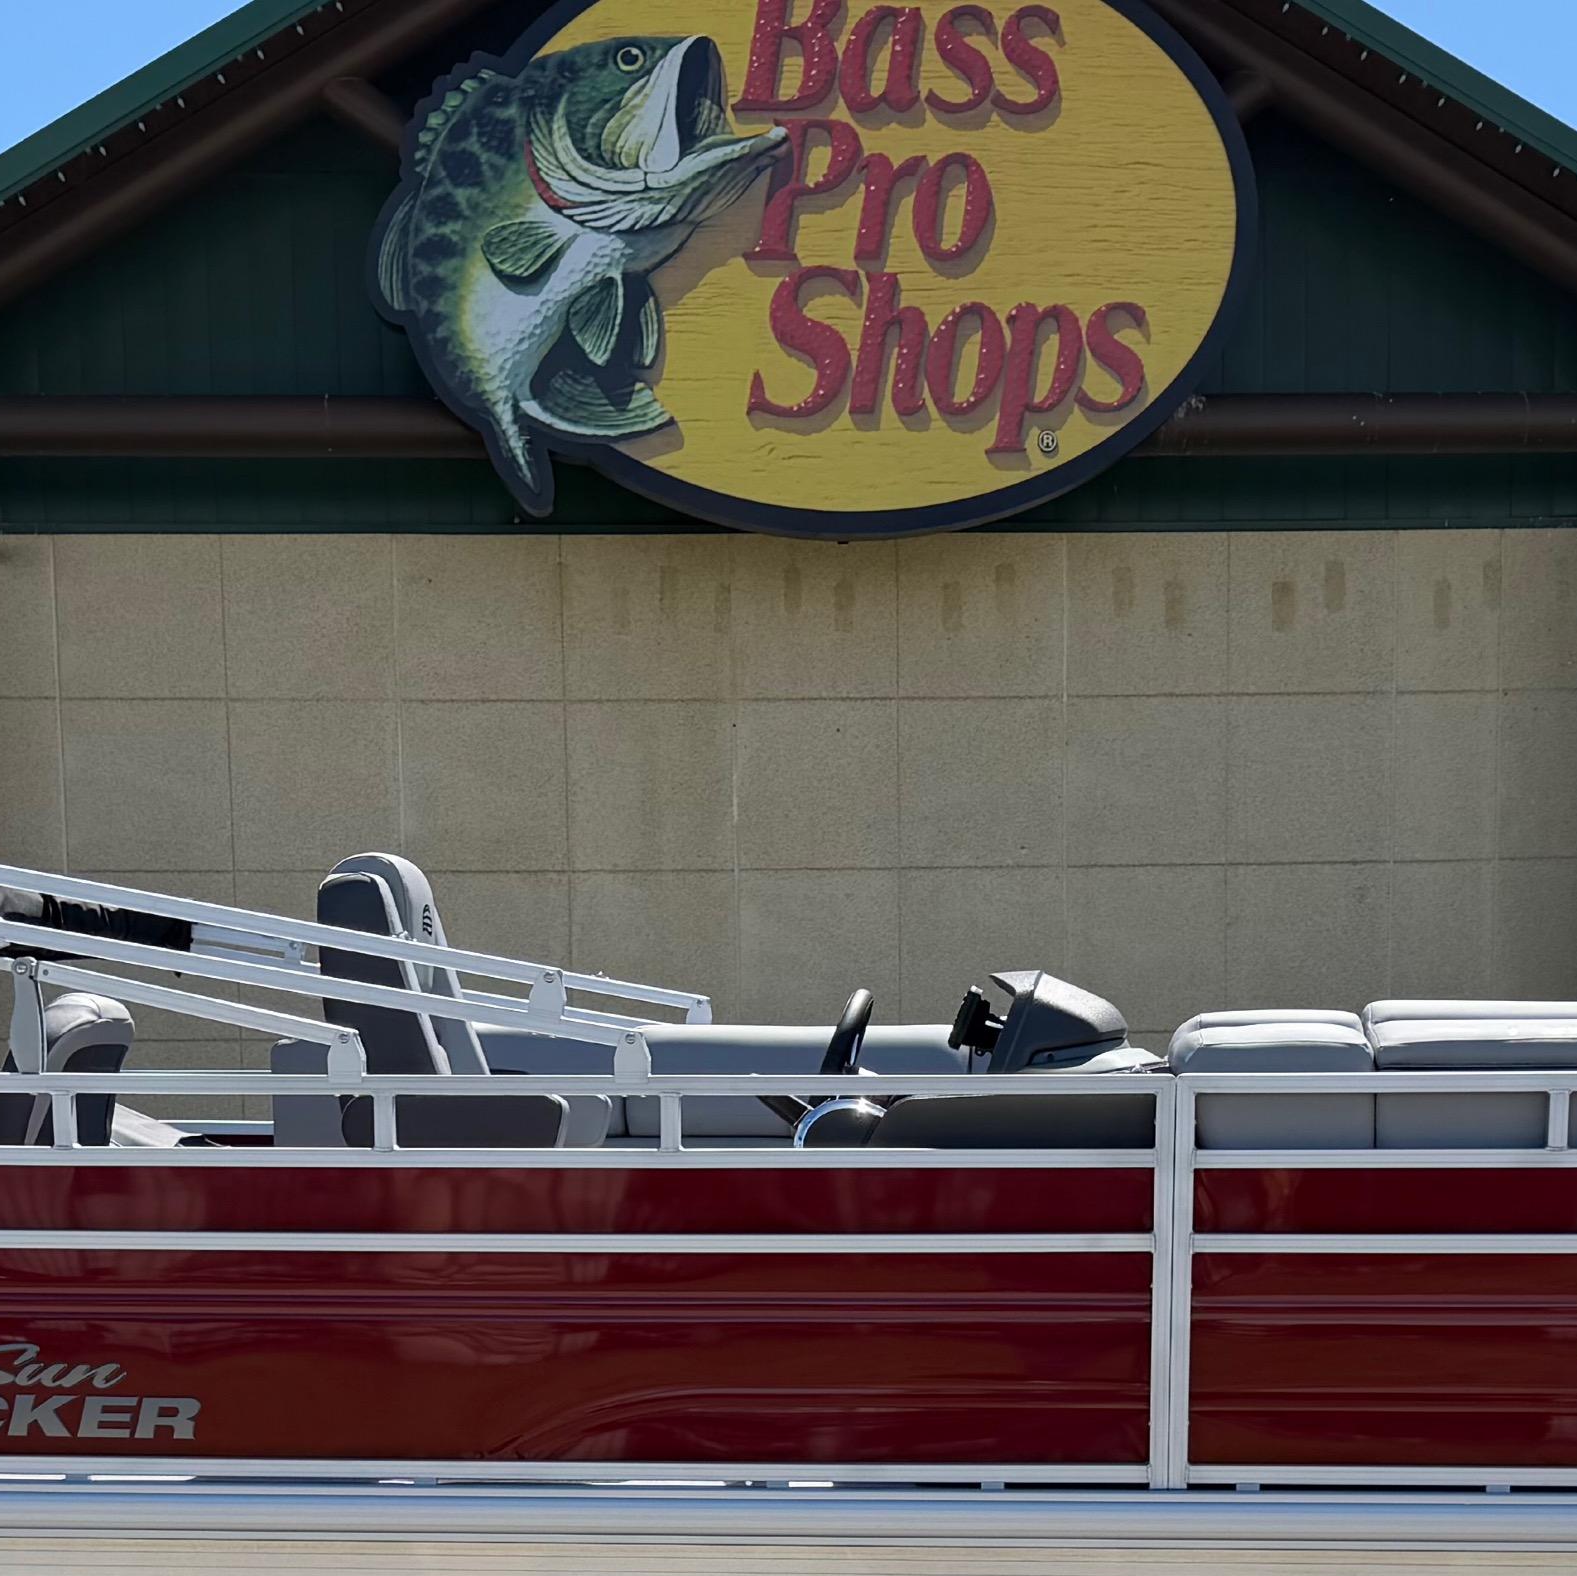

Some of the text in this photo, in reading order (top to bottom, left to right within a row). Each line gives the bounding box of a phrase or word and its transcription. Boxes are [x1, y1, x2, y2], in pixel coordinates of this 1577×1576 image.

[731, 0, 1062, 114] Bass
[742, 118, 994, 262] Pro
[746, 265, 1146, 454] Shops
